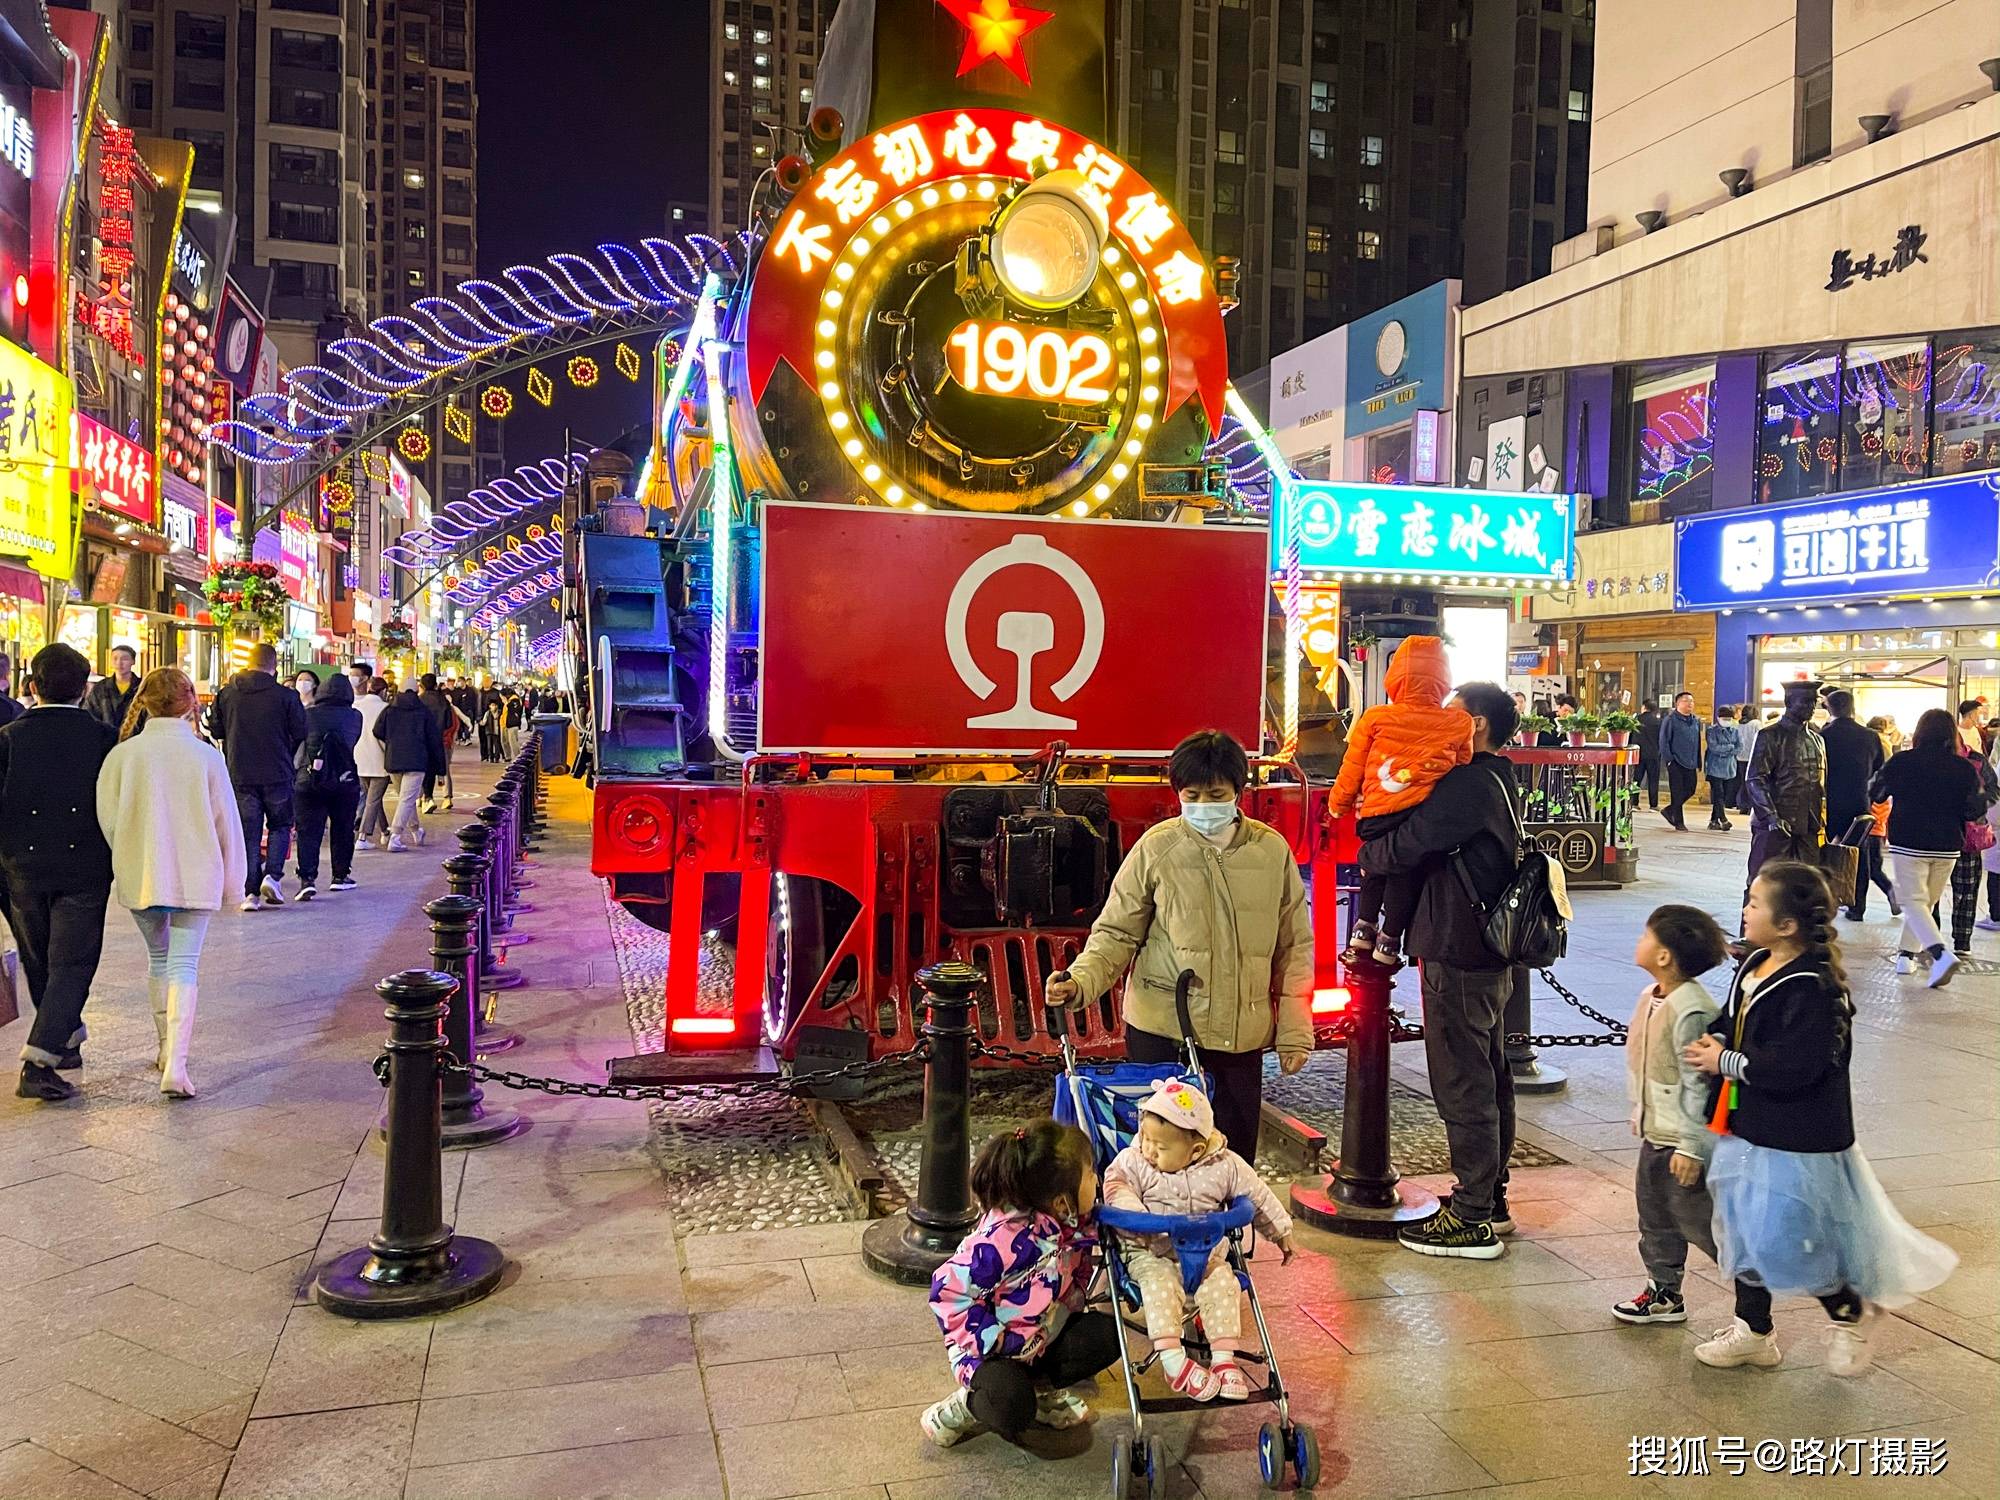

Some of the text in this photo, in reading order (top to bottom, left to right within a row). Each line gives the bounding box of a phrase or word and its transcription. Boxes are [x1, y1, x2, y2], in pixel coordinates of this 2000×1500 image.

[774, 114, 1205, 305] 不忘初心牢记使命
[951, 323, 1111, 402] 1902
[1347, 498, 1547, 568] 雪恋冰城
[1567, 753, 1585, 762] 902
[1517, 839, 1588, 862] 光里
